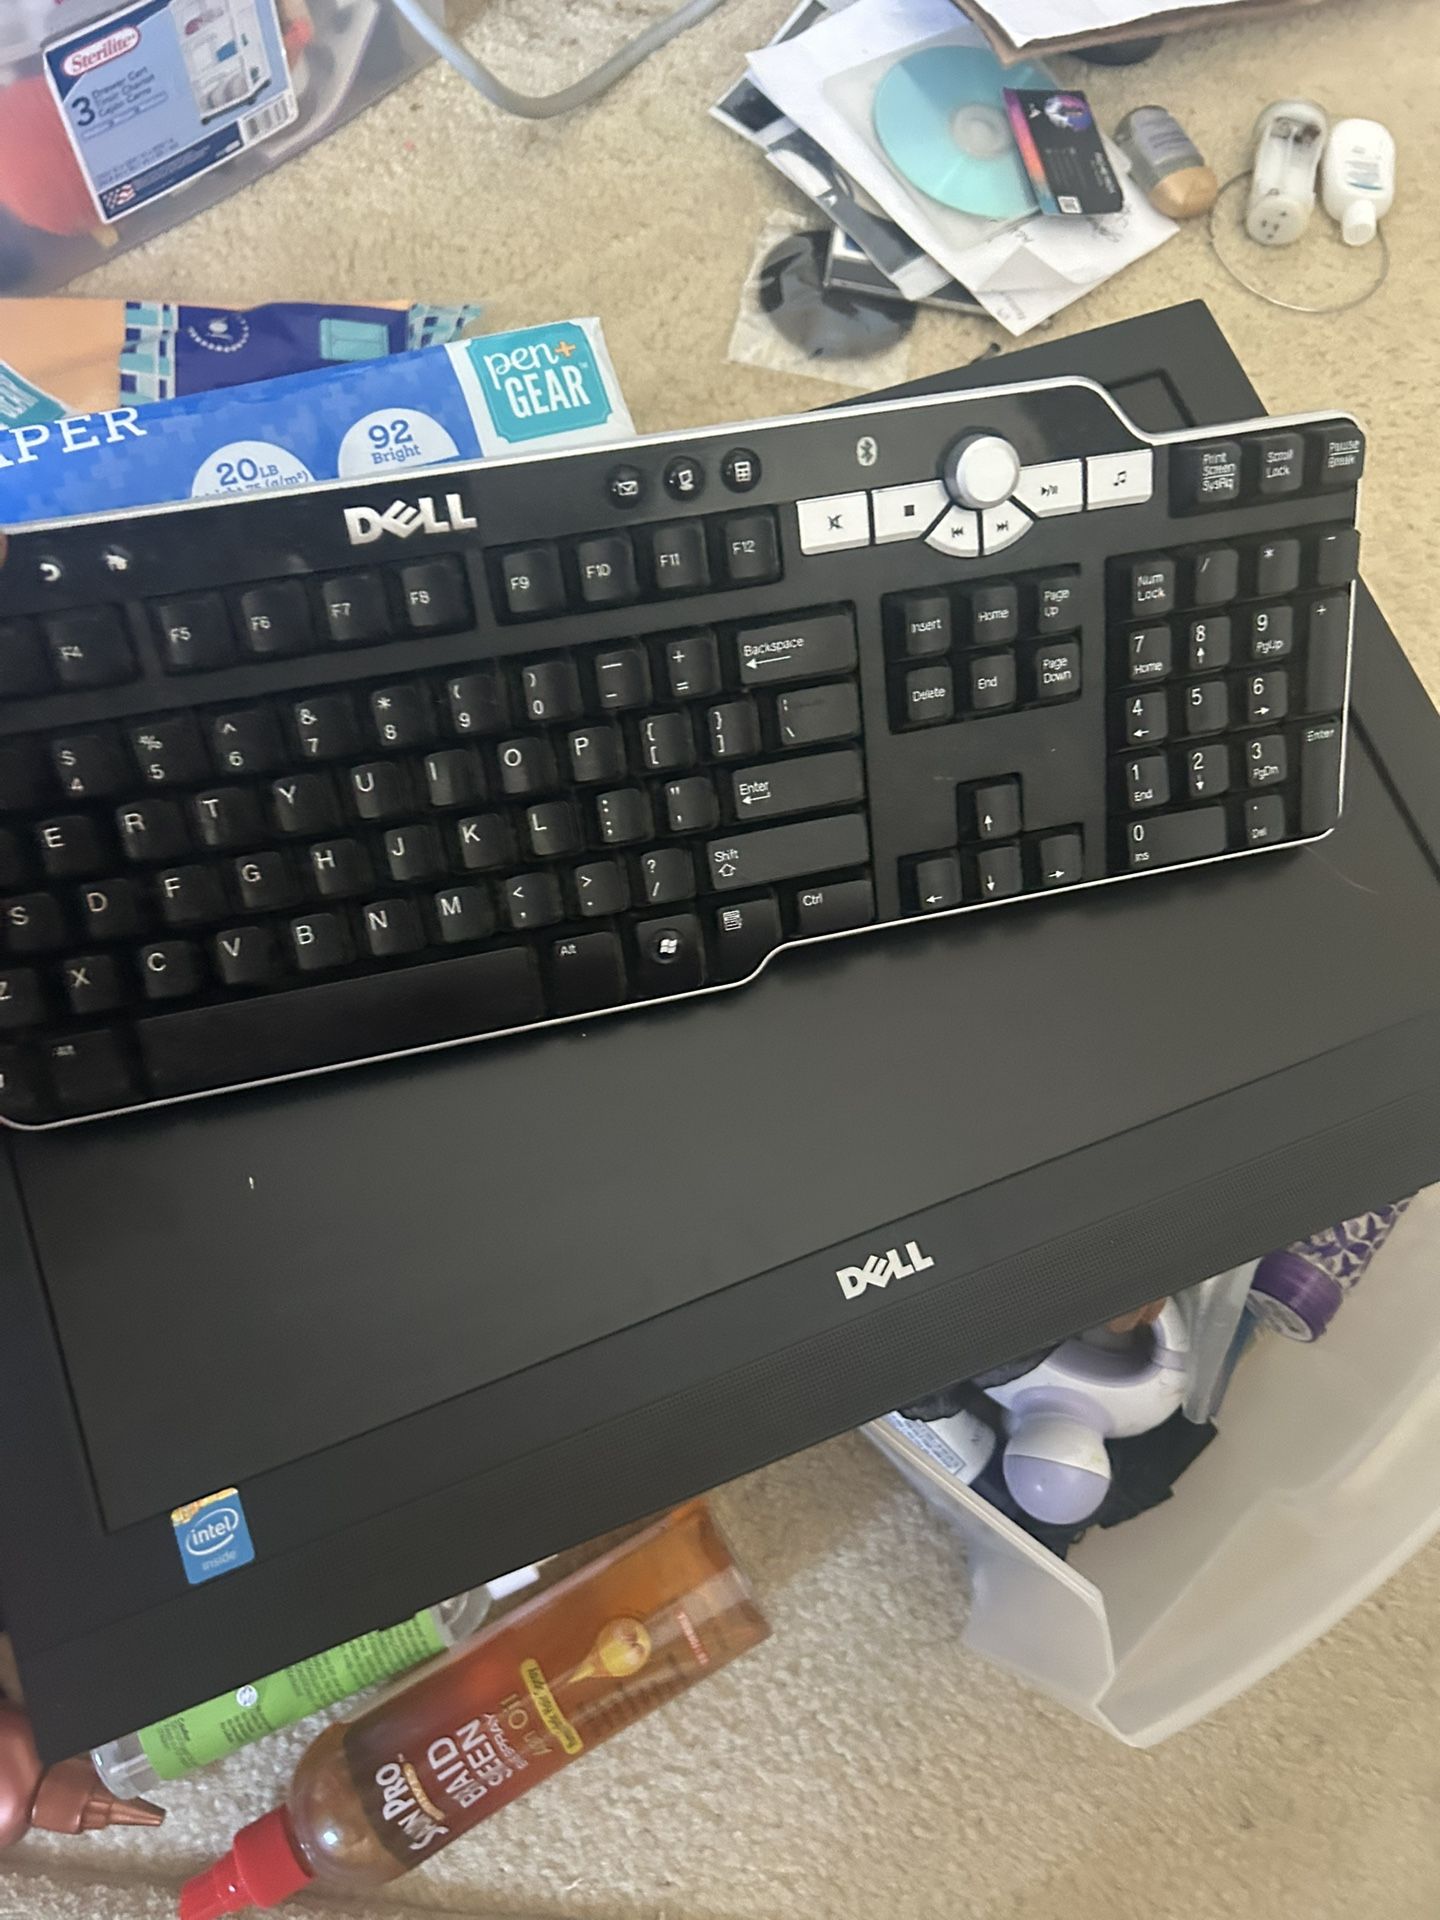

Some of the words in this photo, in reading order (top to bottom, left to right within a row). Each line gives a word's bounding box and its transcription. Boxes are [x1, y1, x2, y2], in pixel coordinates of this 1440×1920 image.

[70, 36, 131, 74] Sterilite
[71, 96, 96, 127] 3
[504, 365, 591, 418] GEAR
[0, 407, 148, 468] PER
[368, 419, 414, 449] 92
[371, 444, 422, 465] Bright
[1329, 439, 1361, 454] Pause
[1202, 452, 1229, 467] Print
[1266, 448, 1294, 464] Scroll
[1202, 462, 1236, 478] Screen
[1266, 465, 1291, 479] Lock
[343, 493, 478, 546] DELL
[732, 539, 756, 555] F12
[659, 552, 681, 567] F11
[585, 563, 611, 579] F10
[510, 575, 530, 590] F9
[1137, 573, 1164, 589] Num
[409, 590, 430, 605] F8
[1044, 588, 1070, 602] Page
[1137, 587, 1166, 602] Lock
[977, 608, 1009, 622] Home
[1044, 606, 1059, 617] Up
[250, 615, 271, 631] F6
[911, 618, 942, 633] Insert
[1257, 614, 1268, 632] 9
[169, 626, 191, 643] F5
[1195, 624, 1206, 642] 8
[743, 637, 805, 658] Backspace
[1133, 634, 1145, 653] 7
[1256, 639, 1284, 654] PgUp
[672, 650, 686, 663] +
[1042, 657, 1068, 670] Page
[1043, 669, 1072, 684] Down
[1133, 661, 1163, 675] Home
[676, 681, 689, 691] =
[977, 676, 998, 690] End
[1253, 677, 1264, 695] 6
[912, 687, 946, 702] Delete
[1191, 687, 1203, 706] 5
[1132, 699, 1144, 716] 4
[458, 712, 471, 728] 9
[384, 724, 397, 740] 8
[1306, 729, 1335, 742] Enter
[306, 737, 319, 753] 7
[574, 736, 589, 756] P
[1251, 742, 1262, 760] 3
[228, 751, 243, 767] 6
[503, 748, 522, 767] O
[1192, 752, 1204, 771] 2
[150, 763, 165, 780] 5
[428, 761, 438, 781] I
[1131, 764, 1140, 781] 1
[1253, 765, 1279, 781] PgDn
[354, 772, 374, 793] U
[739, 780, 770, 796] Enter
[277, 785, 296, 804] Y
[1134, 788, 1153, 802] End
[202, 798, 219, 818] T
[123, 812, 145, 833] R
[531, 813, 548, 832] L
[43, 827, 65, 848] E
[461, 823, 481, 844] K
[1133, 824, 1145, 842] 0
[391, 837, 405, 857] J
[314, 849, 335, 870] H
[713, 850, 739, 864] Shift
[1135, 851, 1150, 862] Ins
[241, 863, 262, 883] G
[164, 877, 181, 898] F
[86, 892, 107, 913] D
[440, 895, 462, 916] M
[802, 892, 823, 906] Ctrl
[9, 906, 29, 926] S
[368, 910, 388, 931] N
[295, 924, 314, 945] B
[221, 937, 241, 957] V
[560, 944, 576, 956] Alt
[147, 952, 166, 972] C
[70, 967, 90, 988] X
[836, 1241, 935, 1300] DELL
[191, 1515, 232, 1546] intel
[202, 1550, 237, 1570] inside
[375, 1762, 416, 1821] PRO
[397, 1808, 449, 1850] SN
